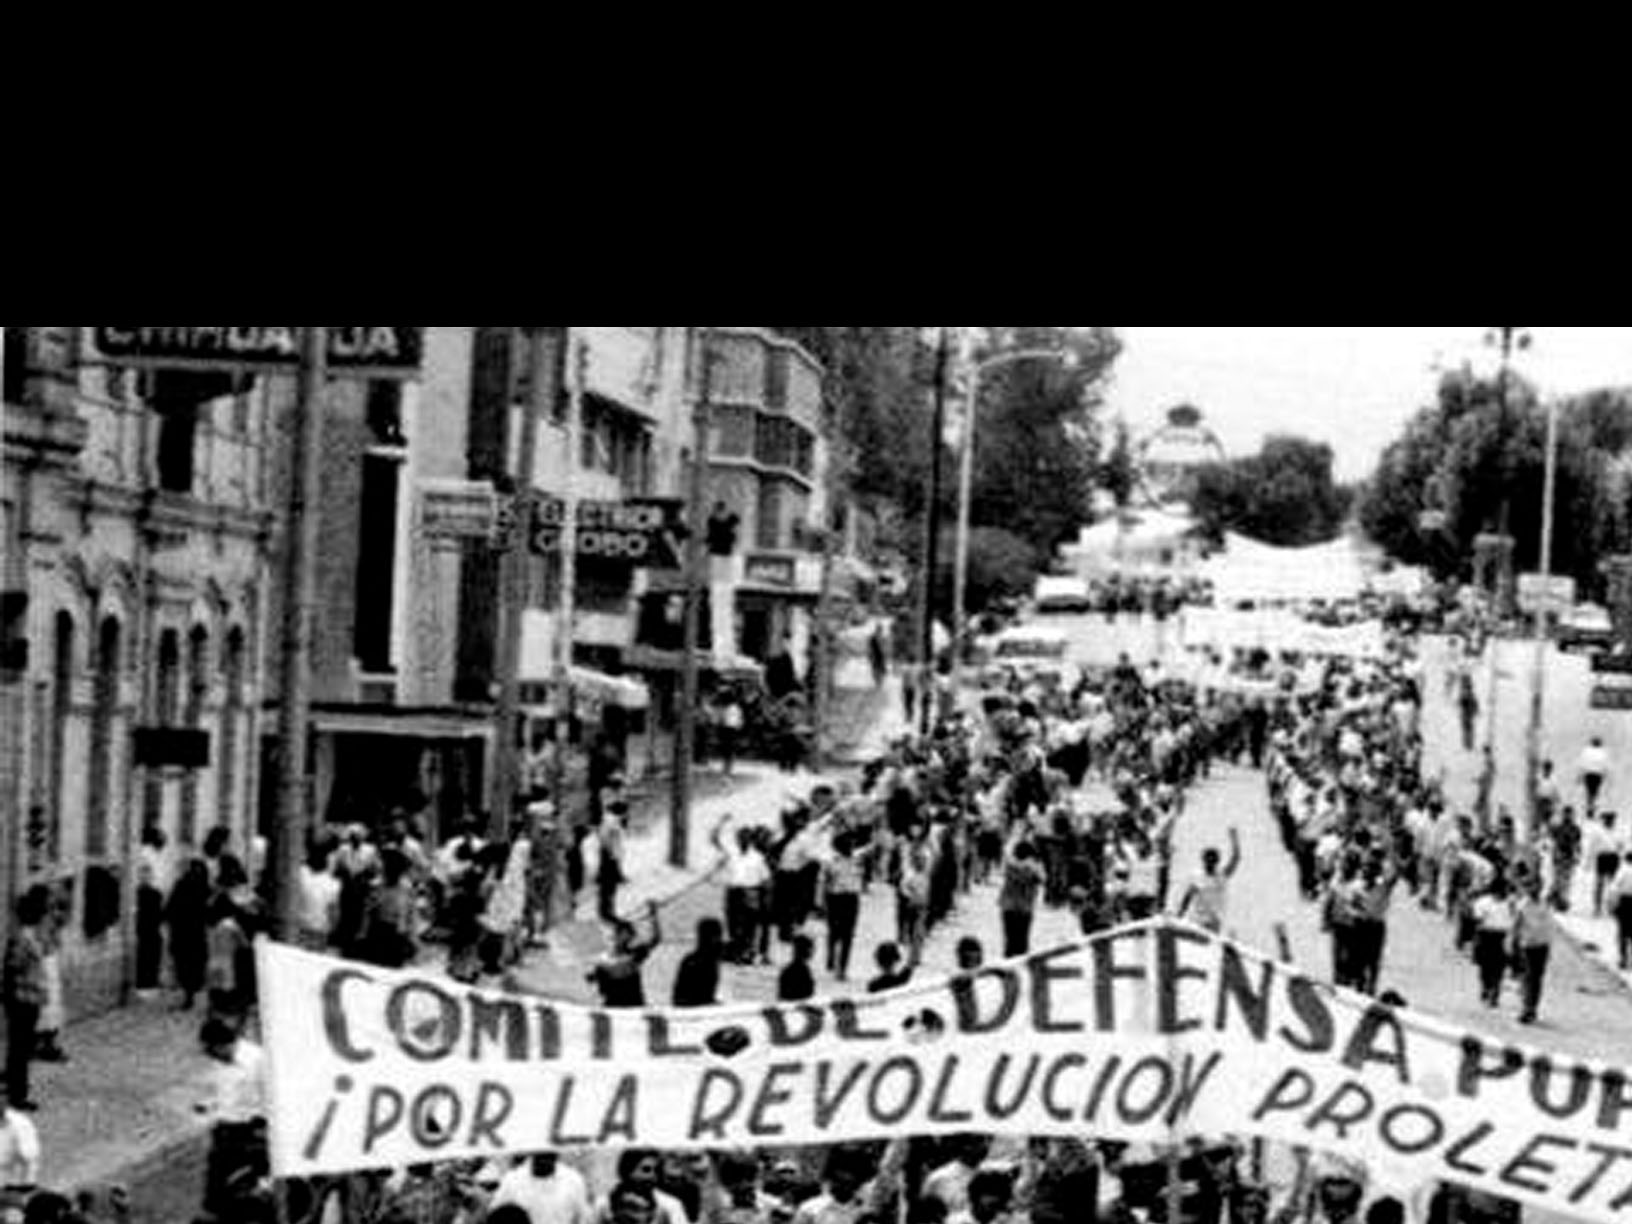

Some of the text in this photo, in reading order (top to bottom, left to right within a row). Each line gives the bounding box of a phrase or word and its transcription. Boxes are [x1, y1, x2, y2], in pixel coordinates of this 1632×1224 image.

[951, 926, 1410, 1083] DEFENSA
[303, 1074, 514, 1159] ¡POR
[549, 1073, 639, 1146] LA
[688, 1052, 1222, 1142] REVOLUCION
